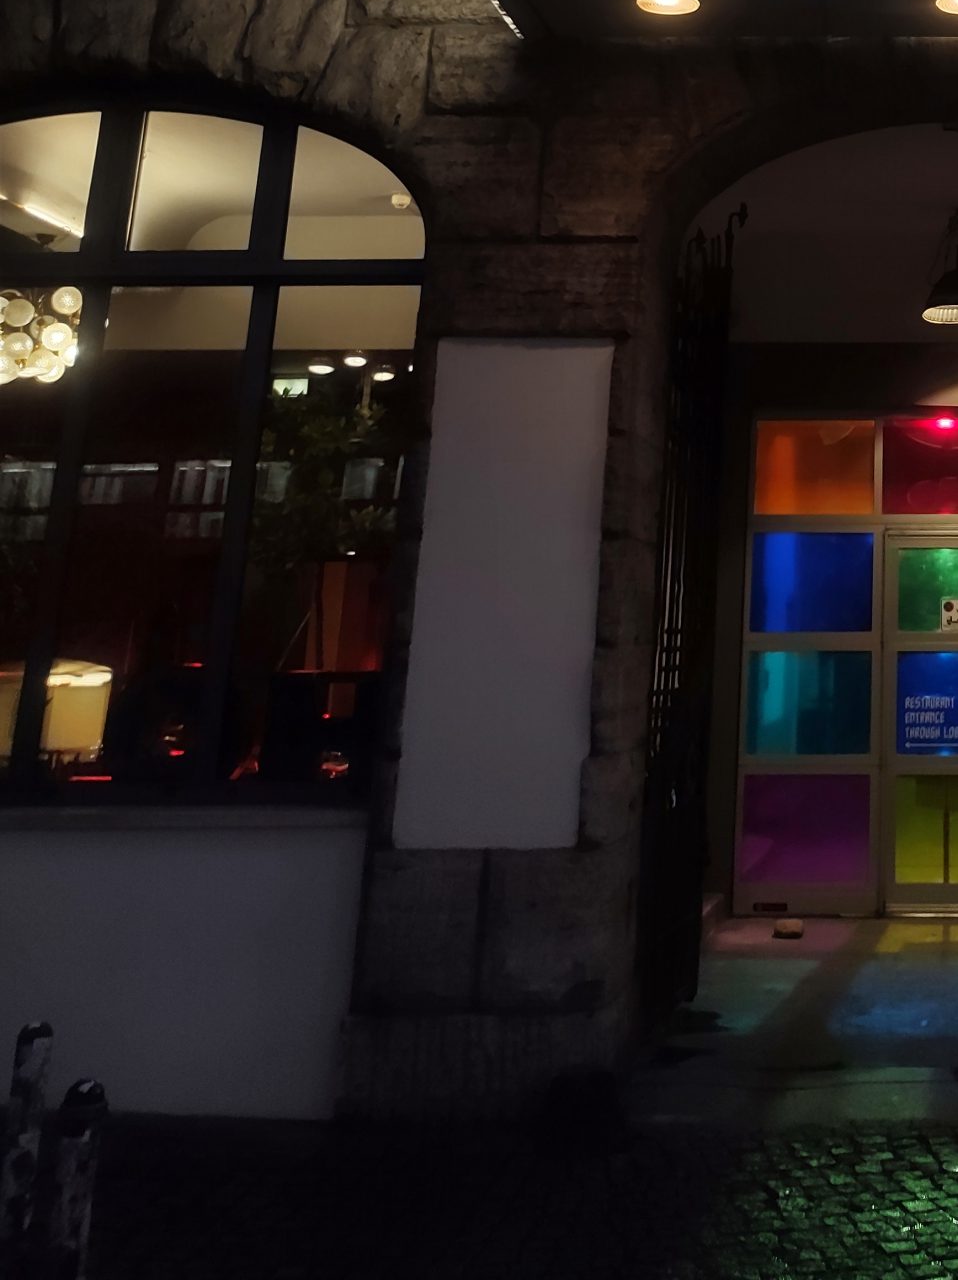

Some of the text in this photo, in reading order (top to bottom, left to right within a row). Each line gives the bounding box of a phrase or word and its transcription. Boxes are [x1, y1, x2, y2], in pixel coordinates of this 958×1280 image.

[905, 696, 955, 709] RESTAURANT
[905, 711, 945, 724] ENTRANCE
[905, 726, 941, 739] THROUGH
